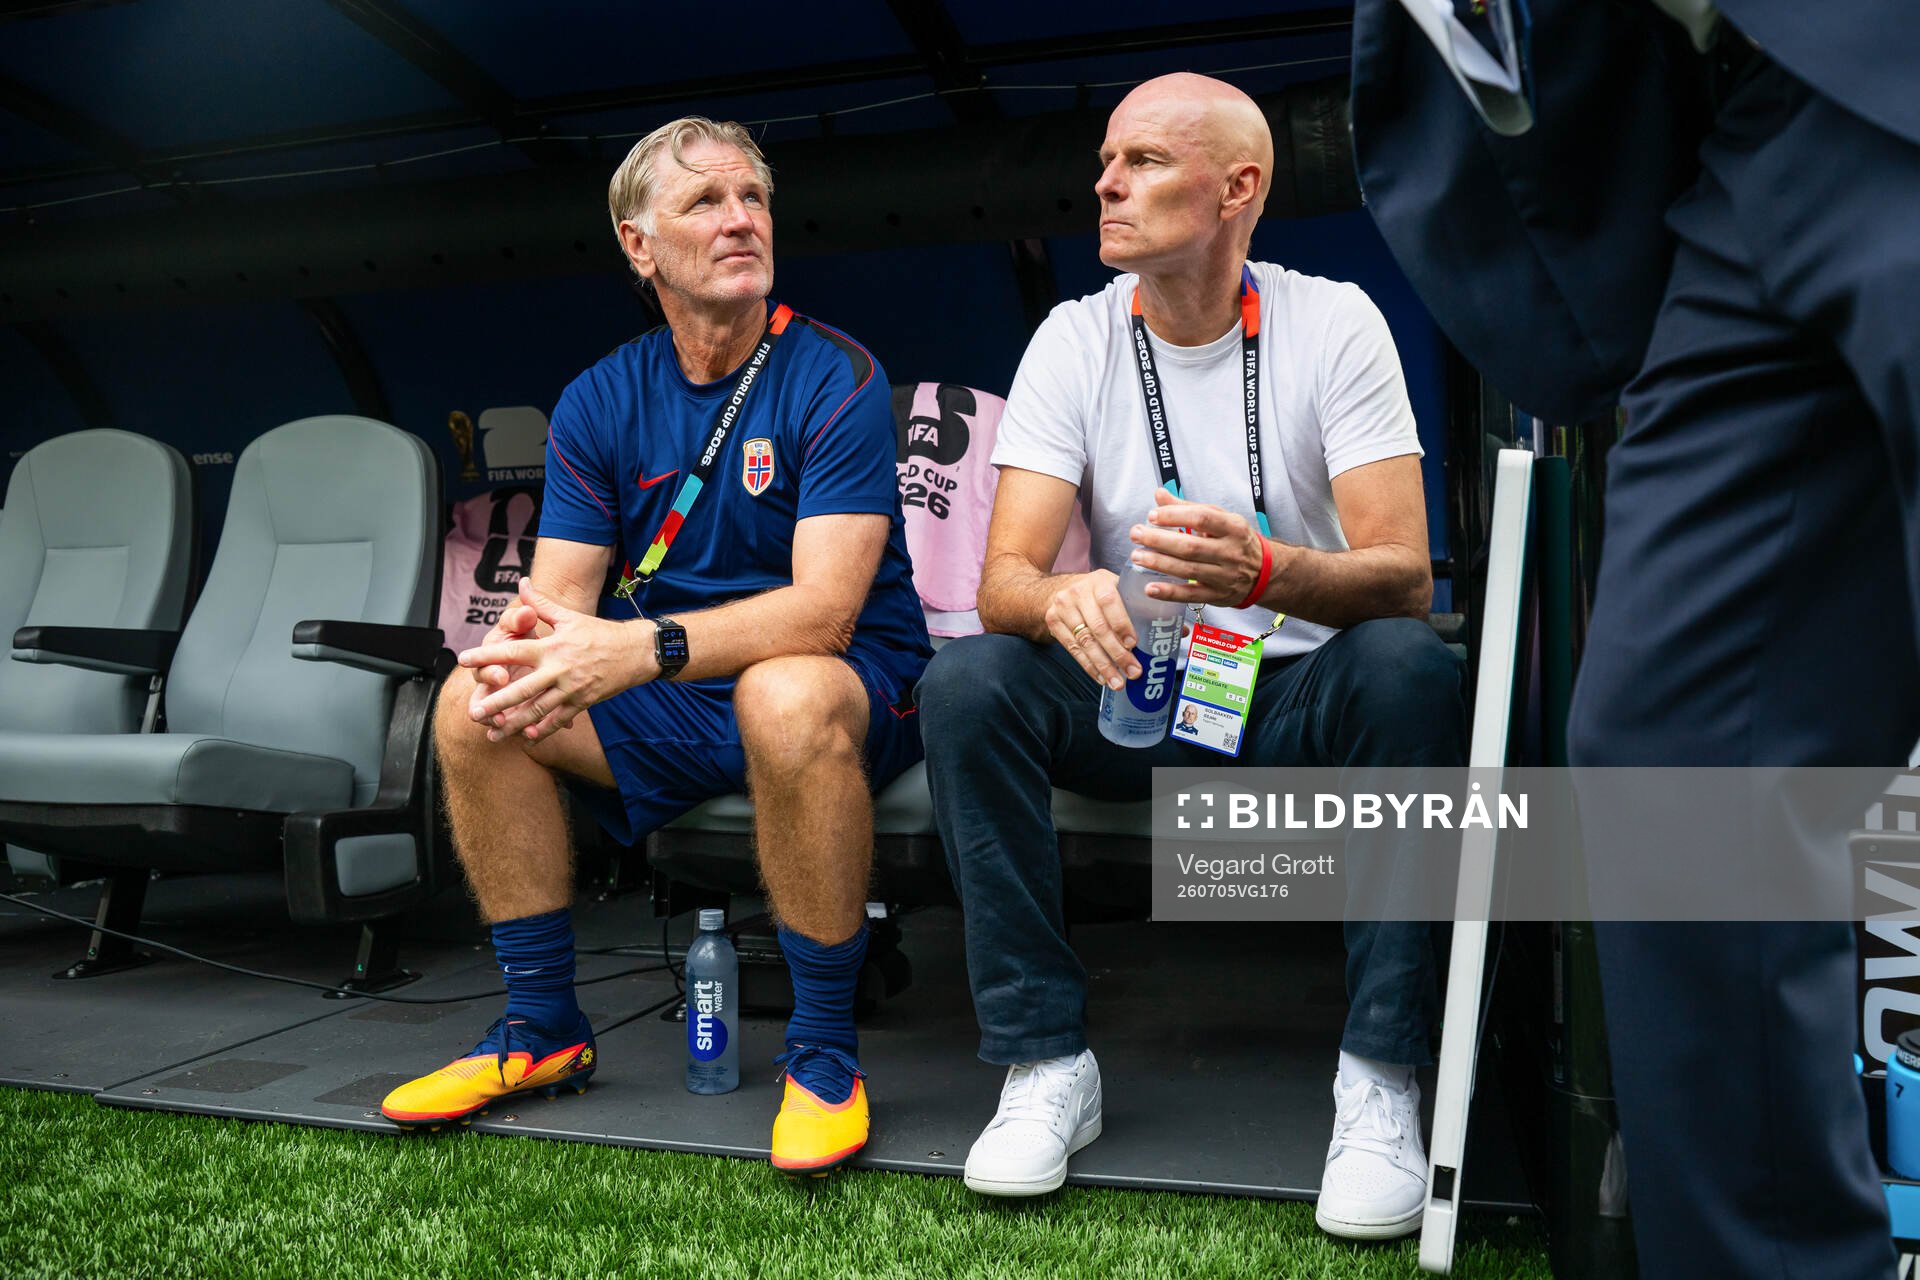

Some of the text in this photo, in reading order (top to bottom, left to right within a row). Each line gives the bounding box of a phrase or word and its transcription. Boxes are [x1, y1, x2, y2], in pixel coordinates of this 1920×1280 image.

[701, 342, 771, 466] FIFA WORLD CUP 2026
[1135, 328, 1173, 469] FIFA WORLD CUP 2026
[1246, 350, 1261, 499] FIFA WORLD CUP 2026
[193, 452, 233, 464] ense
[488, 468, 546, 481] FIFA WOR
[923, 468, 958, 493] CUP
[494, 571, 521, 584] FIFA
[1195, 634, 1207, 642] FIFA
[1207, 638, 1226, 647] WORLD
[1226, 642, 1237, 650] CUP
[1144, 617, 1175, 700] smart
[714, 981, 723, 1012] water
[694, 980, 713, 1051] smart
[1895, 1082, 1904, 1099] 7
